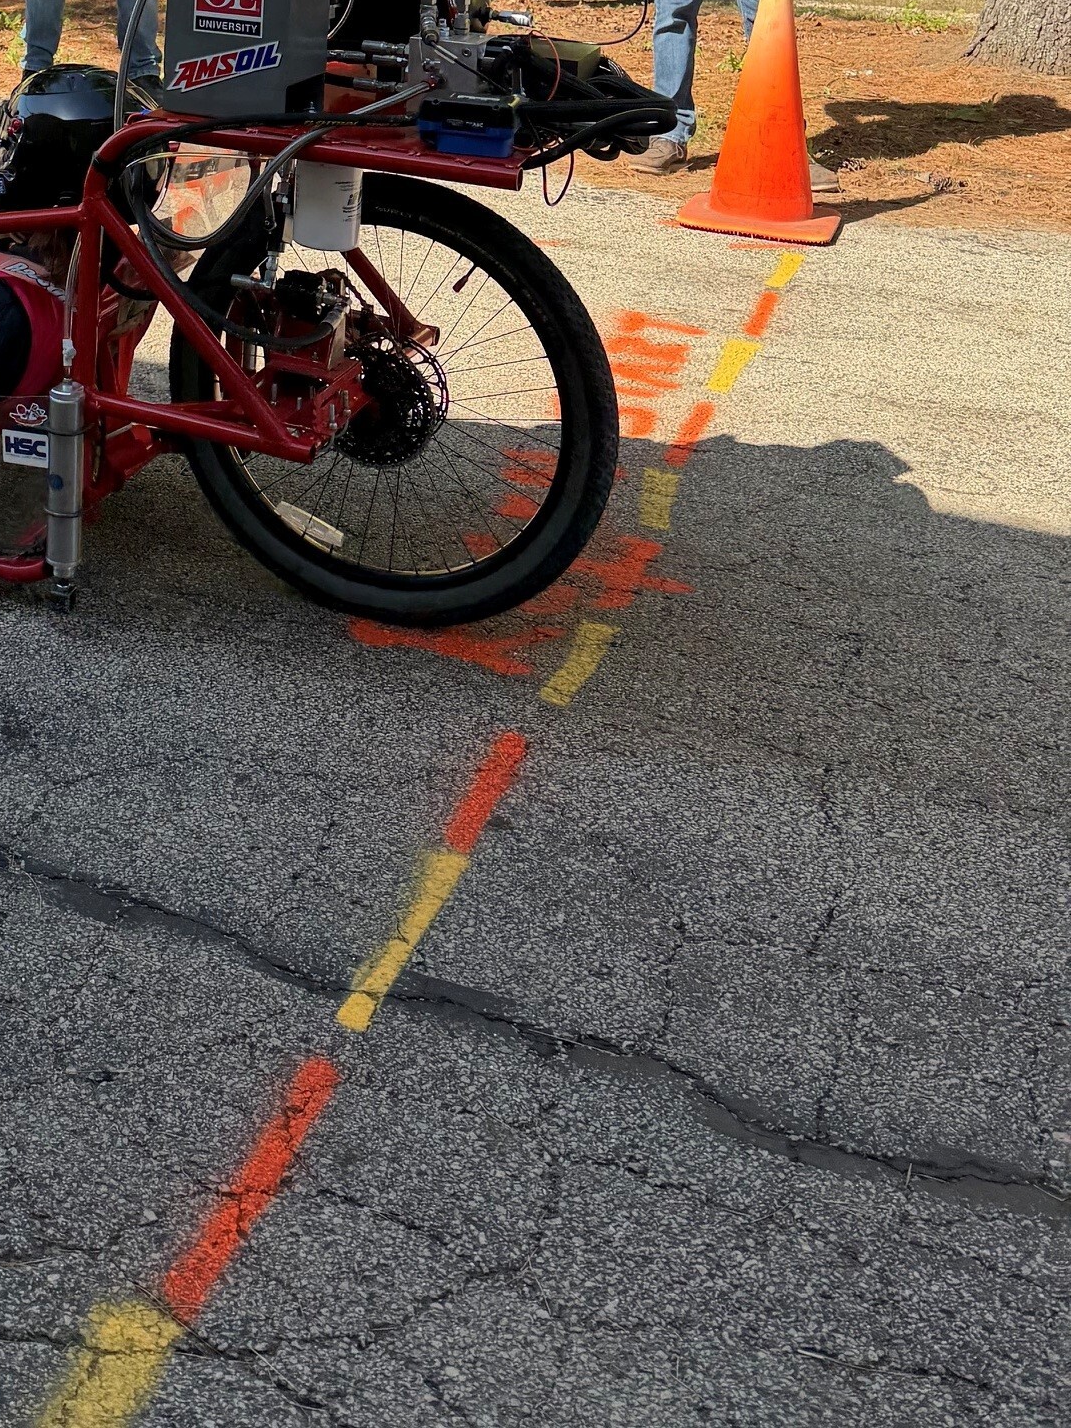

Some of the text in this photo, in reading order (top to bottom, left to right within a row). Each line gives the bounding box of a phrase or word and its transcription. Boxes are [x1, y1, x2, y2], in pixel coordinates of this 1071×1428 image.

[198, 18, 258, 34] UNIVERSITY
[172, 43, 280, 90] AMSOIL
[4, 435, 47, 458] HSC
